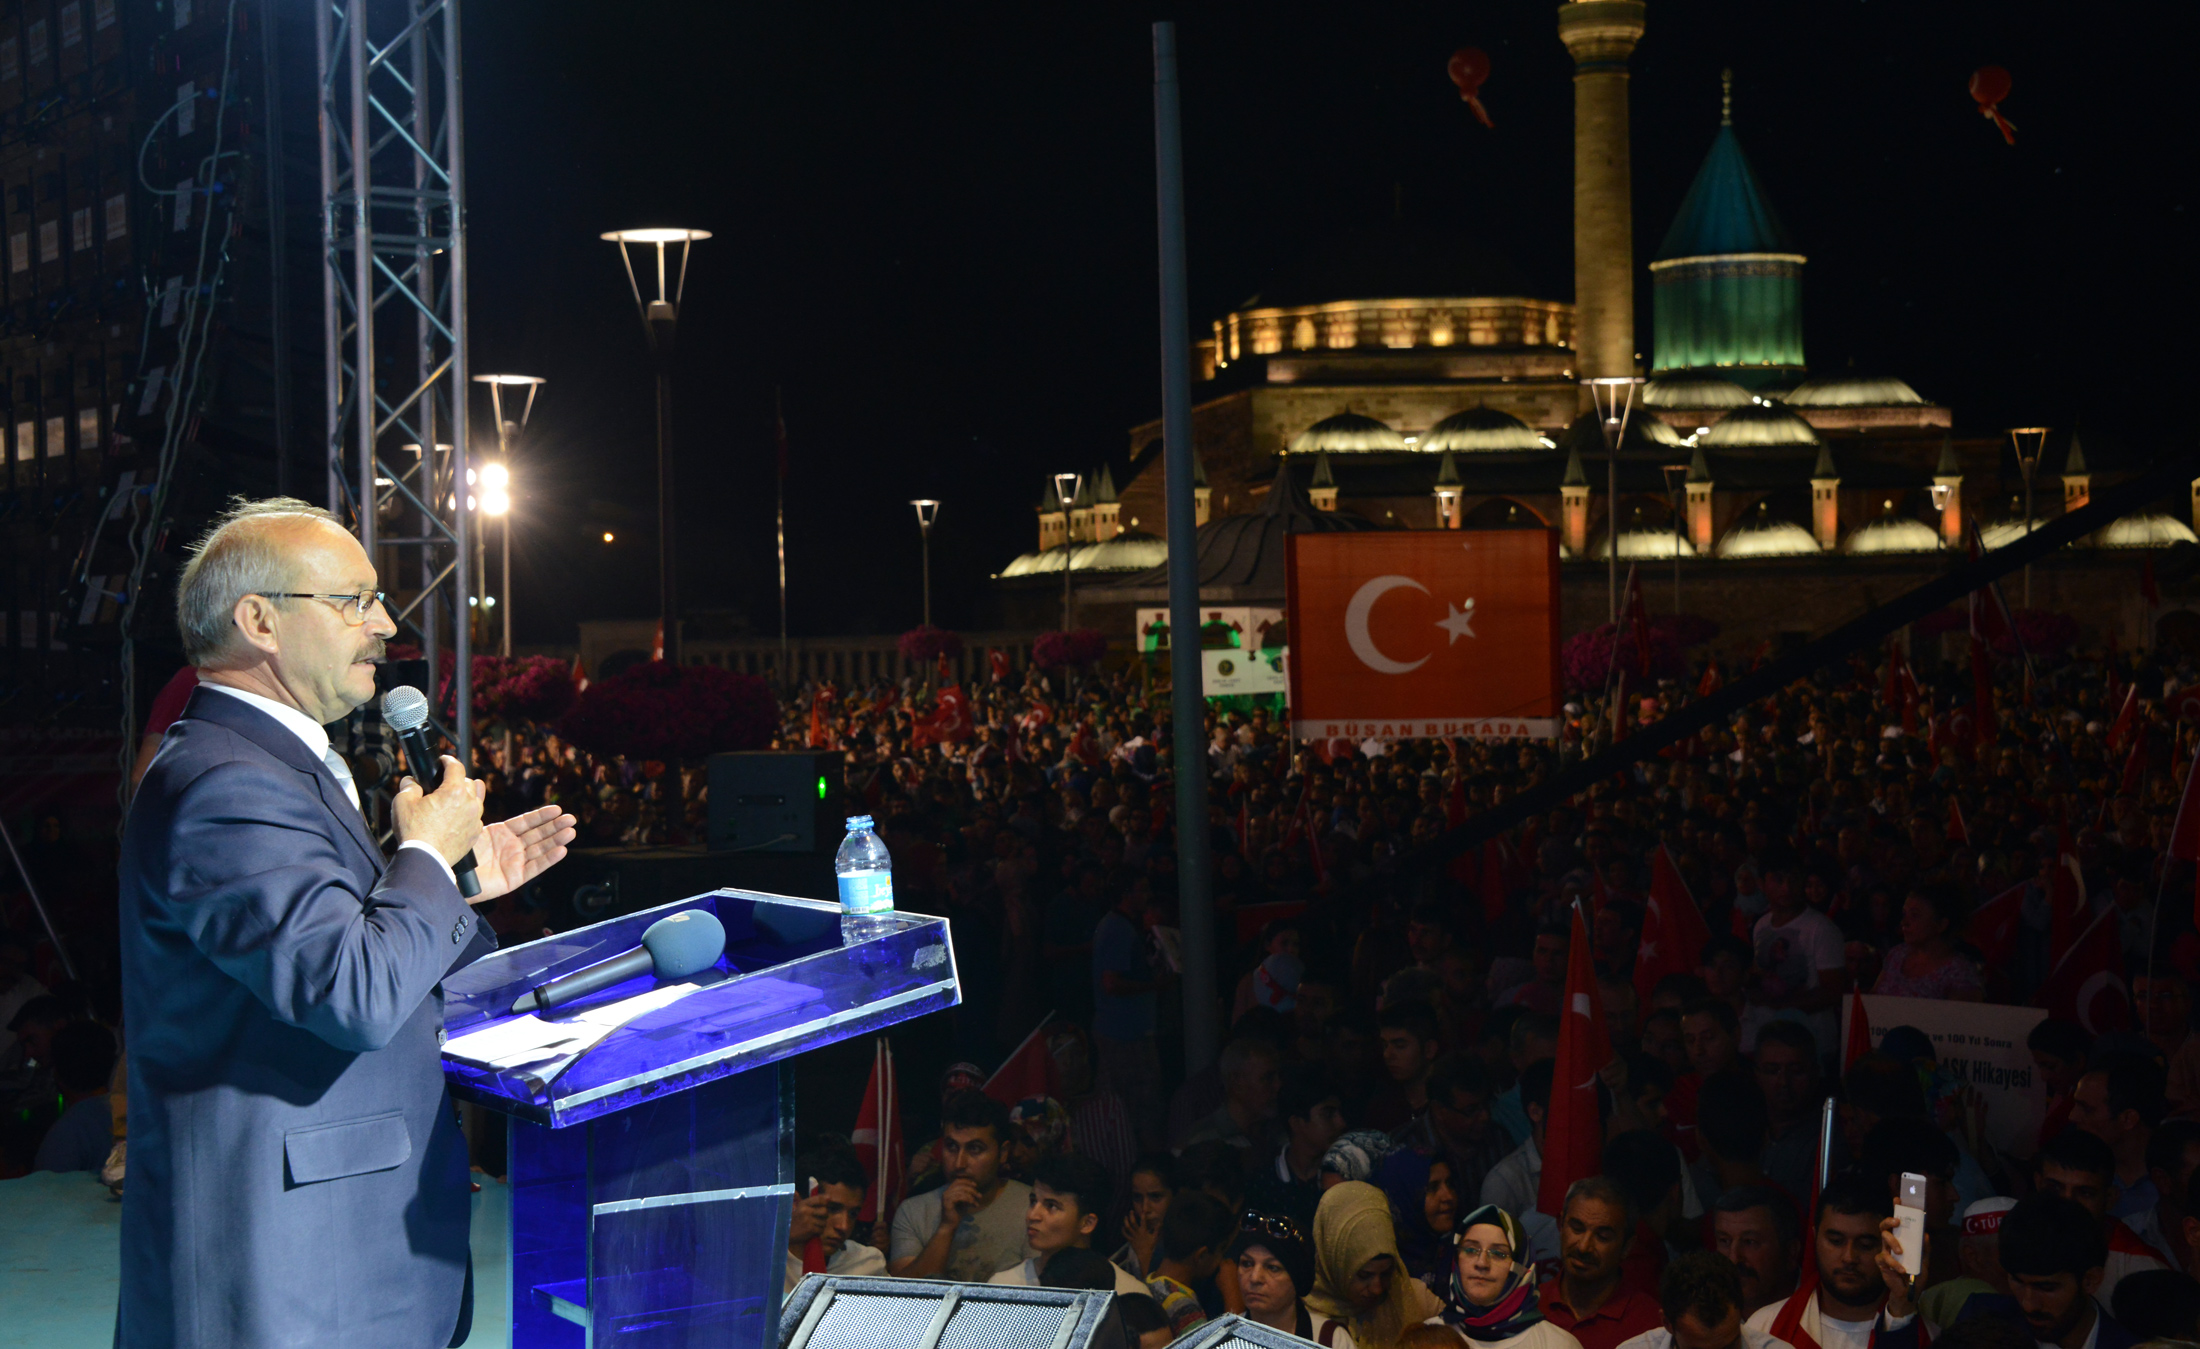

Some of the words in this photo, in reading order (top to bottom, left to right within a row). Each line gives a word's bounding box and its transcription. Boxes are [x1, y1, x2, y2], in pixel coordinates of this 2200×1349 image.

[1425, 723, 1528, 736] BURADA
[1932, 1034, 1943, 1042] ve
[1947, 1033, 1965, 1044] 100
[1983, 1036, 2012, 1049] Sonra
[1972, 1060, 2032, 1091] Hikayesi
